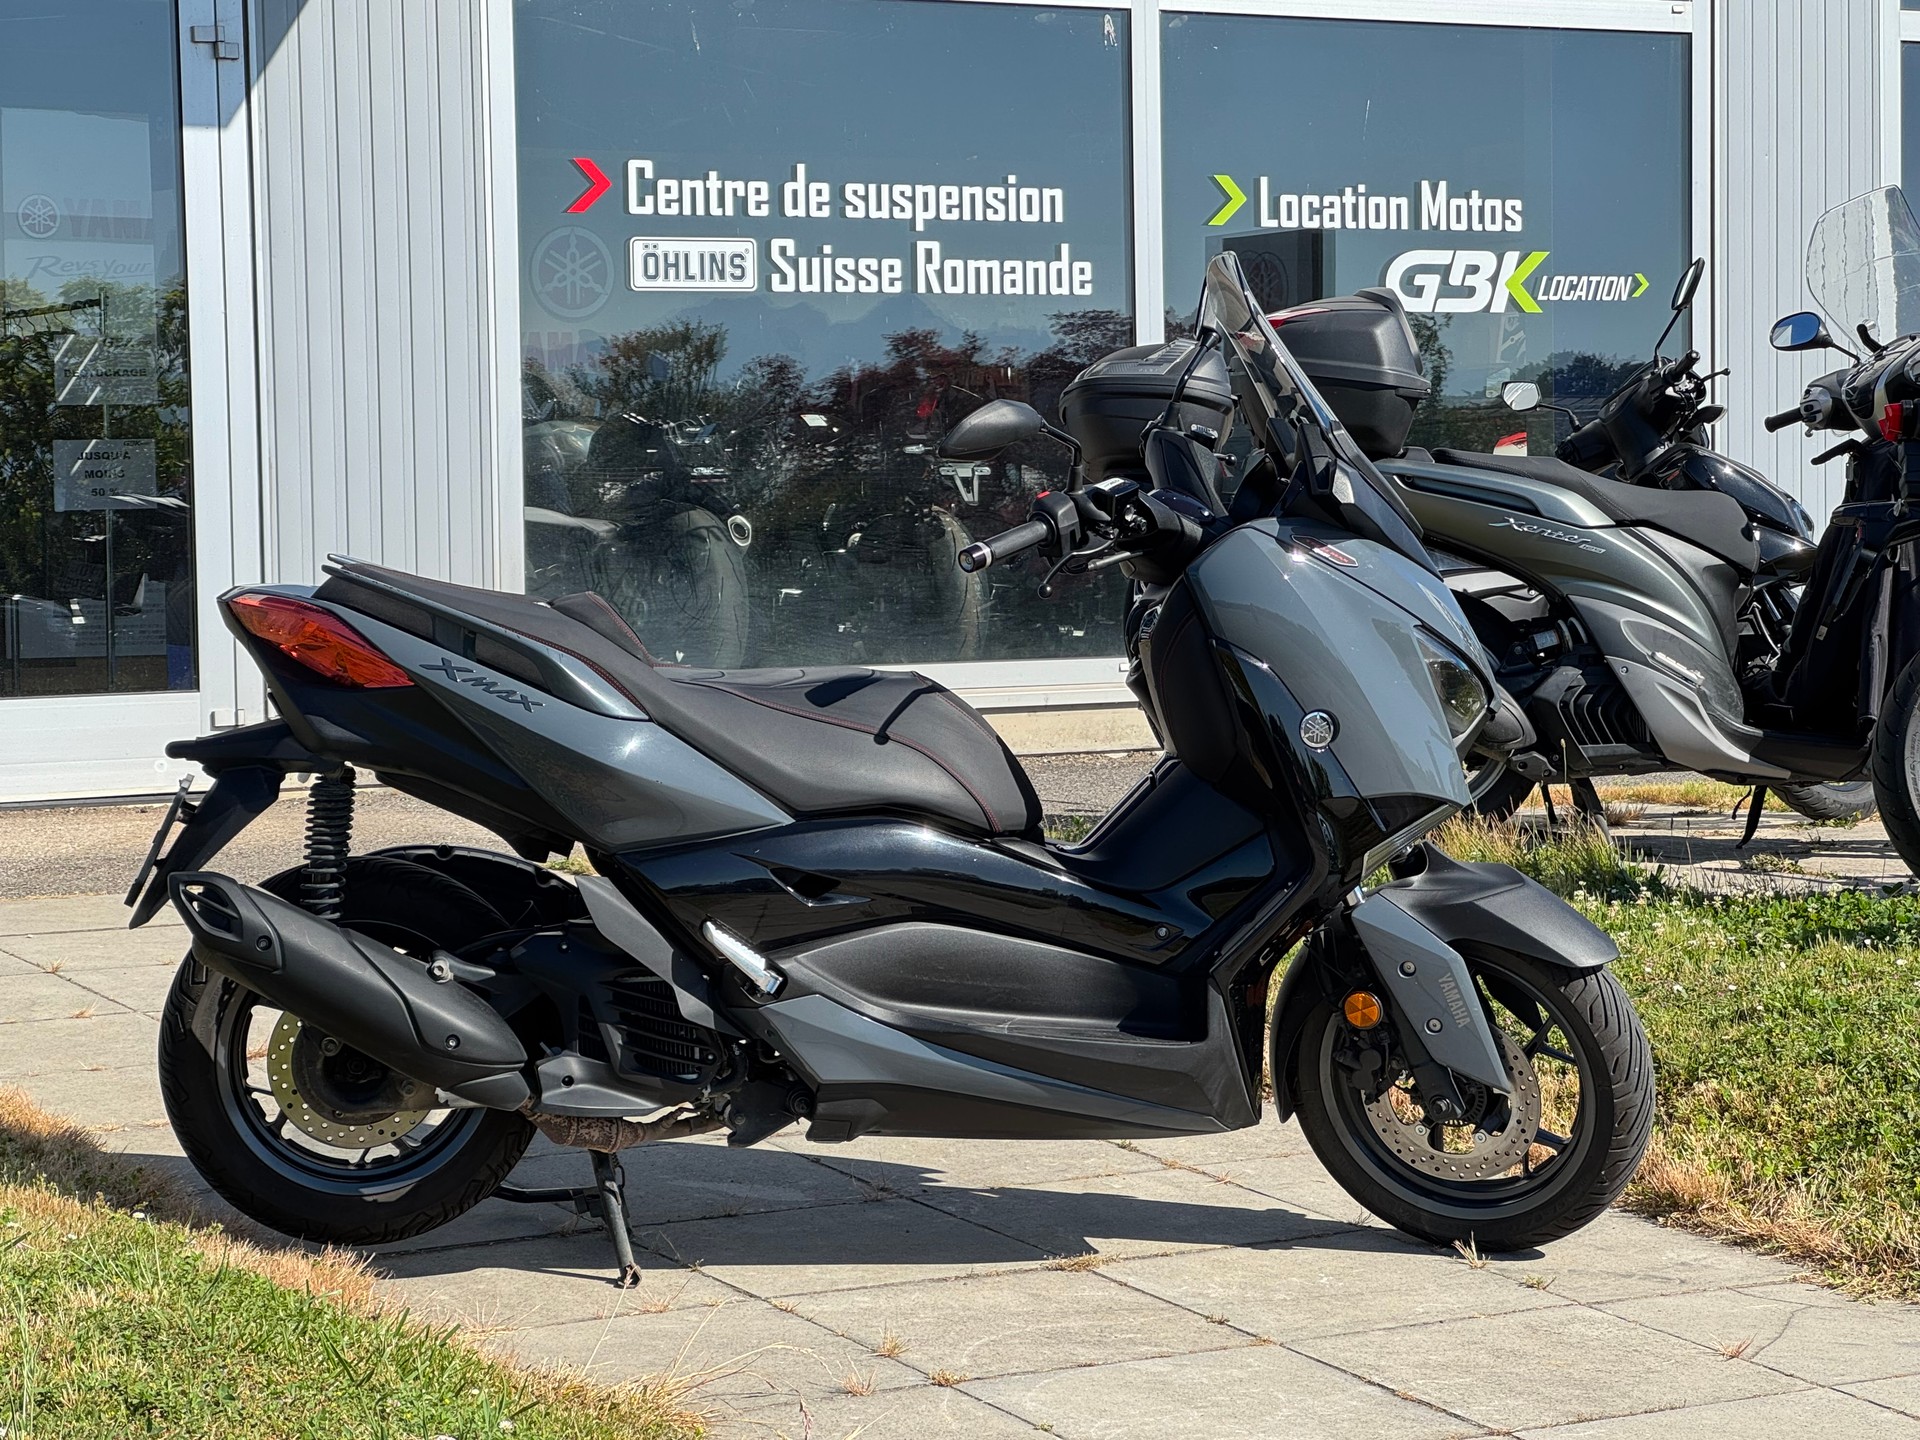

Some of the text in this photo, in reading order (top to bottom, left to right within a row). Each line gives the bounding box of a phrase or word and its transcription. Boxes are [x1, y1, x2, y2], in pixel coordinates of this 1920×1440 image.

[63, 197, 152, 240] YAM
[627, 159, 1064, 232] Centre de suspension
[1259, 175, 1523, 232] Location Motos
[641, 243, 747, 282] ÖHLINS
[770, 238, 1093, 296] Suisse Romande
[1386, 249, 1634, 314] GBK LOCATION
[91, 488, 106, 497] 50
[1438, 972, 1471, 1028] YAMAHA
